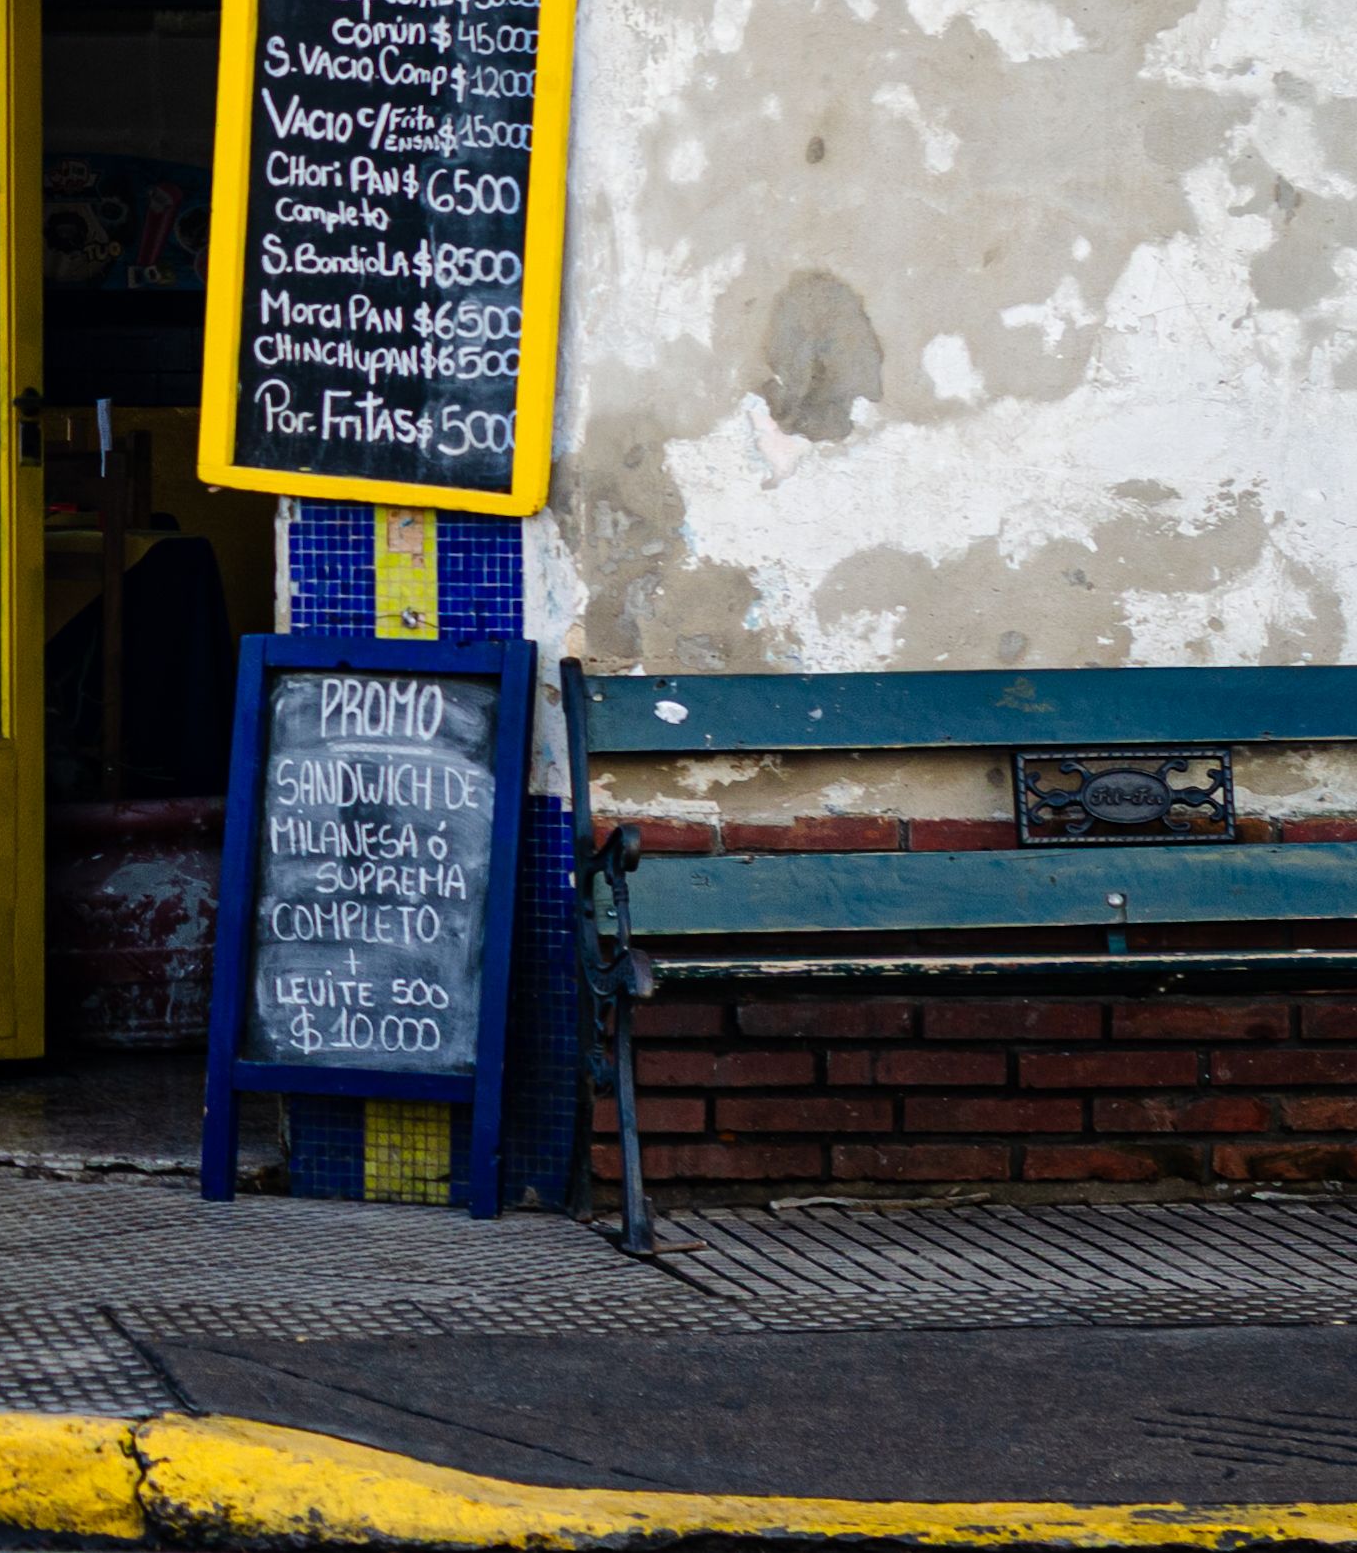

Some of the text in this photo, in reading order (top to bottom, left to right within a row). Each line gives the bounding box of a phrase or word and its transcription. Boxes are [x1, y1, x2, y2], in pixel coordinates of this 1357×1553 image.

[261, 87, 353, 143] VACIO
[349, 155, 401, 196] PAN
[320, 678, 444, 741] PROMO
[444, 767, 480, 808] DE
[314, 861, 466, 900] SUPREMA
[271, 901, 441, 944] COMPLETO
[392, 978, 449, 1010] 500
